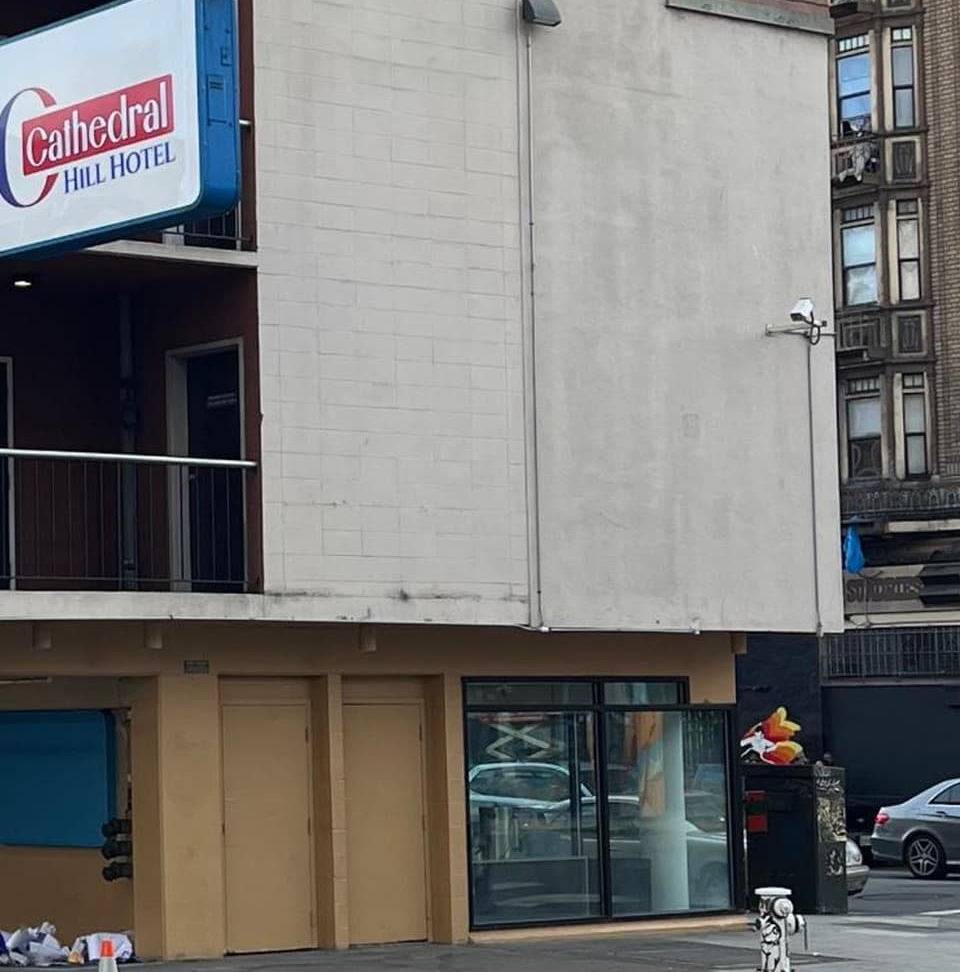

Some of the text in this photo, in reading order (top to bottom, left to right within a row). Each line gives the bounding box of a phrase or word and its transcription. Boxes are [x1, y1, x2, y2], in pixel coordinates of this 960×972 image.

[25, 81, 169, 167] Cathedral
[64, 142, 177, 194] HILL HOTEL
